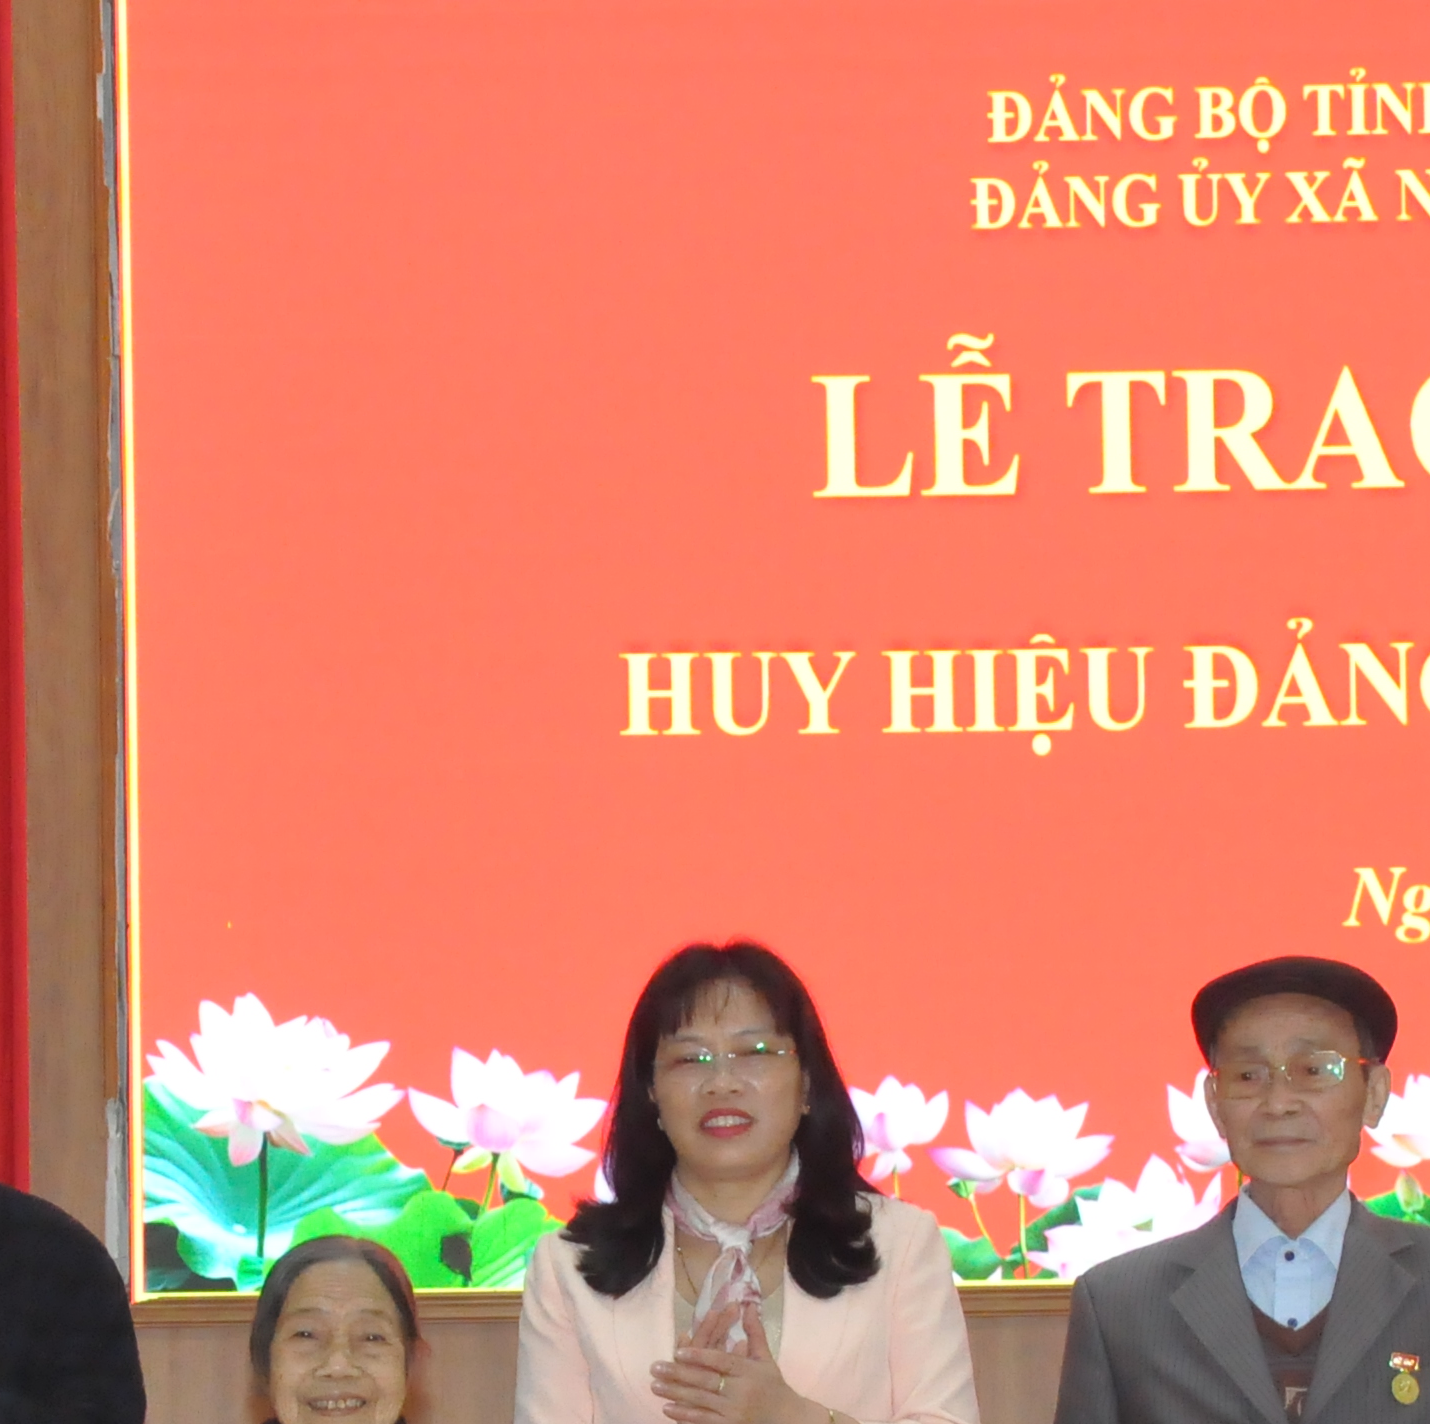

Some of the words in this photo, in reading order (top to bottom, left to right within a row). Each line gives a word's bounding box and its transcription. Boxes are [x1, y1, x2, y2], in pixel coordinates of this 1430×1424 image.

[987, 74, 1177, 143] ĐẢNG
[1195, 77, 1287, 153] BỘ
[970, 160, 1161, 229] ĐẢNG
[1178, 157, 1271, 226] ỦY
[1285, 157, 1378, 223] XÃ
[811, 333, 1019, 498] LỄ
[619, 650, 856, 736] HUY
[881, 634, 1154, 756] HIỆU
